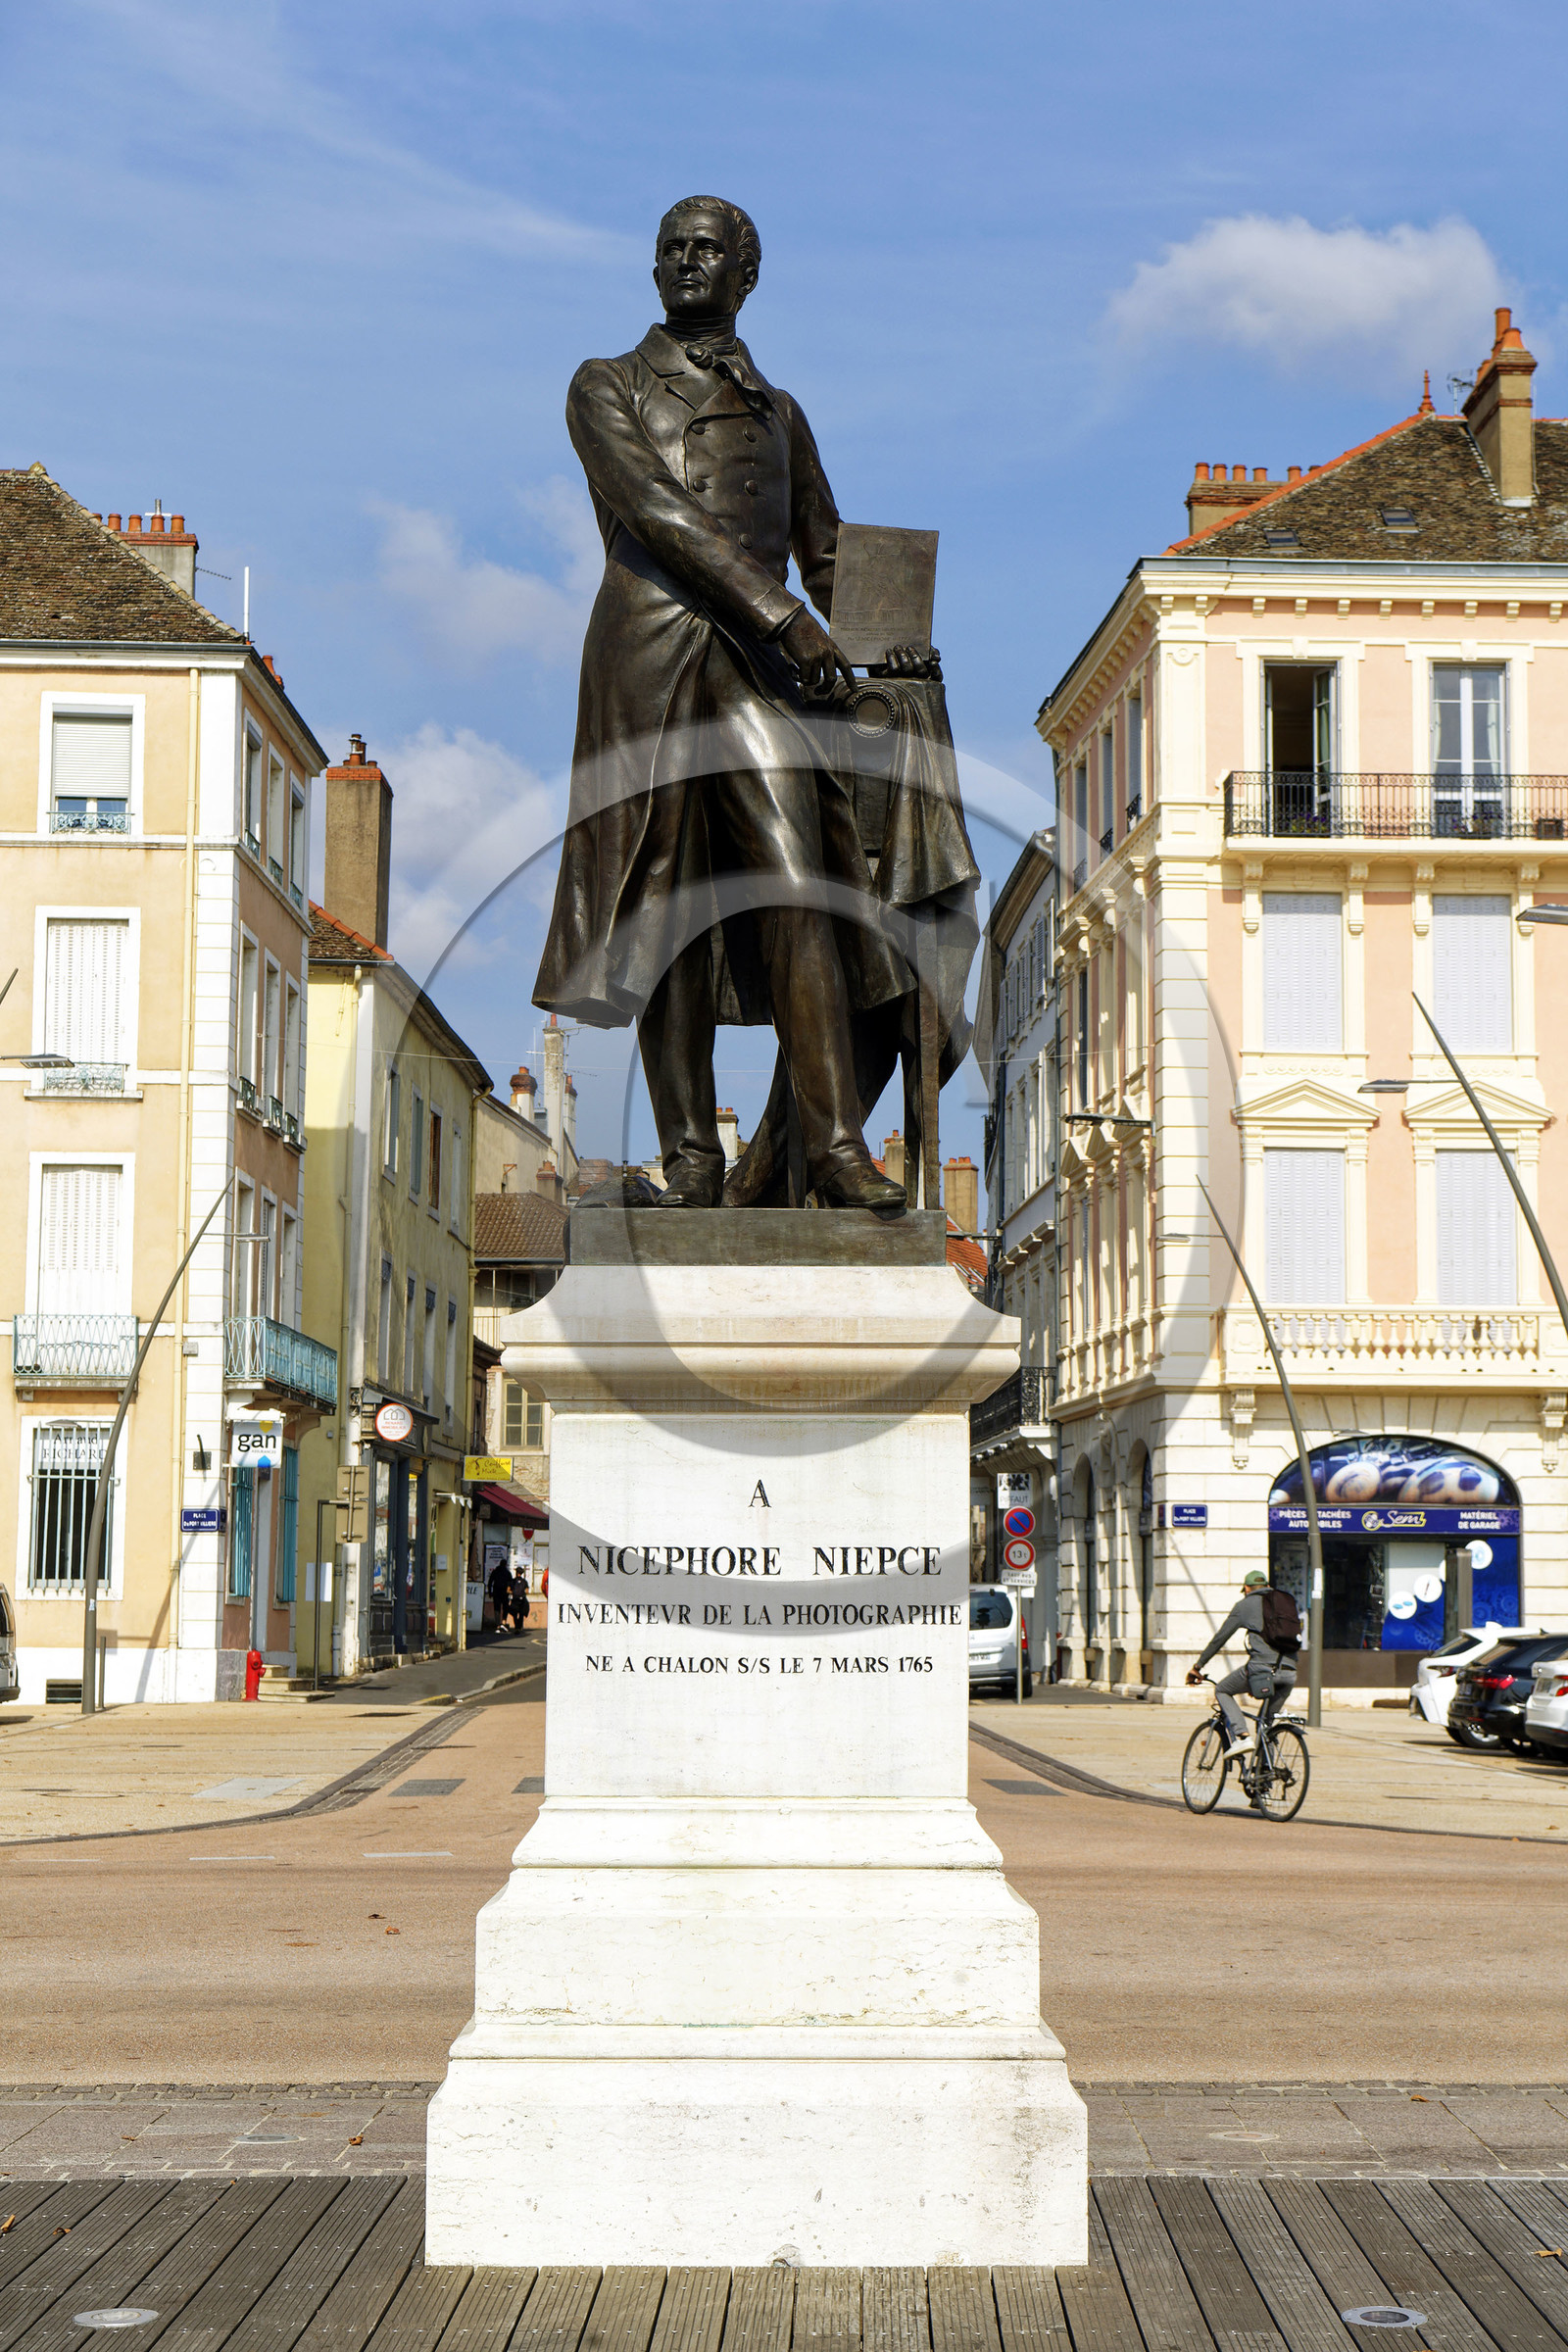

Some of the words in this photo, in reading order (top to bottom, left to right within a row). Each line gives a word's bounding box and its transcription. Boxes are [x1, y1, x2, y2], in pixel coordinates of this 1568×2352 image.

[237, 1434, 277, 1452] gan
[750, 1479, 771, 1508] A
[1279, 1509, 1307, 1518] PIÈCES
[1311, 1509, 1352, 1518] TACHÉES
[1380, 1510, 1422, 1528] Sem
[1460, 1509, 1498, 1520] MATÉRIEL
[1288, 1520, 1343, 1529] AUTOBILES
[1457, 1521, 1469, 1530] DE
[1470, 1521, 1501, 1530] GARAGE
[577, 1545, 782, 1576] NICEPHORE
[812, 1546, 942, 1576] NIEPCE
[558, 1603, 692, 1625] INVENTEVR
[703, 1604, 732, 1625] DE
[743, 1604, 772, 1625] LA
[782, 1603, 962, 1626] PHOTOGRAPHIE
[585, 1655, 613, 1672] NE
[623, 1656, 635, 1672] A
[643, 1656, 728, 1674] CHALON
[738, 1656, 770, 1674] S/S
[780, 1657, 805, 1674] LE
[813, 1657, 822, 1673] 7
[831, 1656, 889, 1673] MARS
[899, 1656, 933, 1673] 1765
